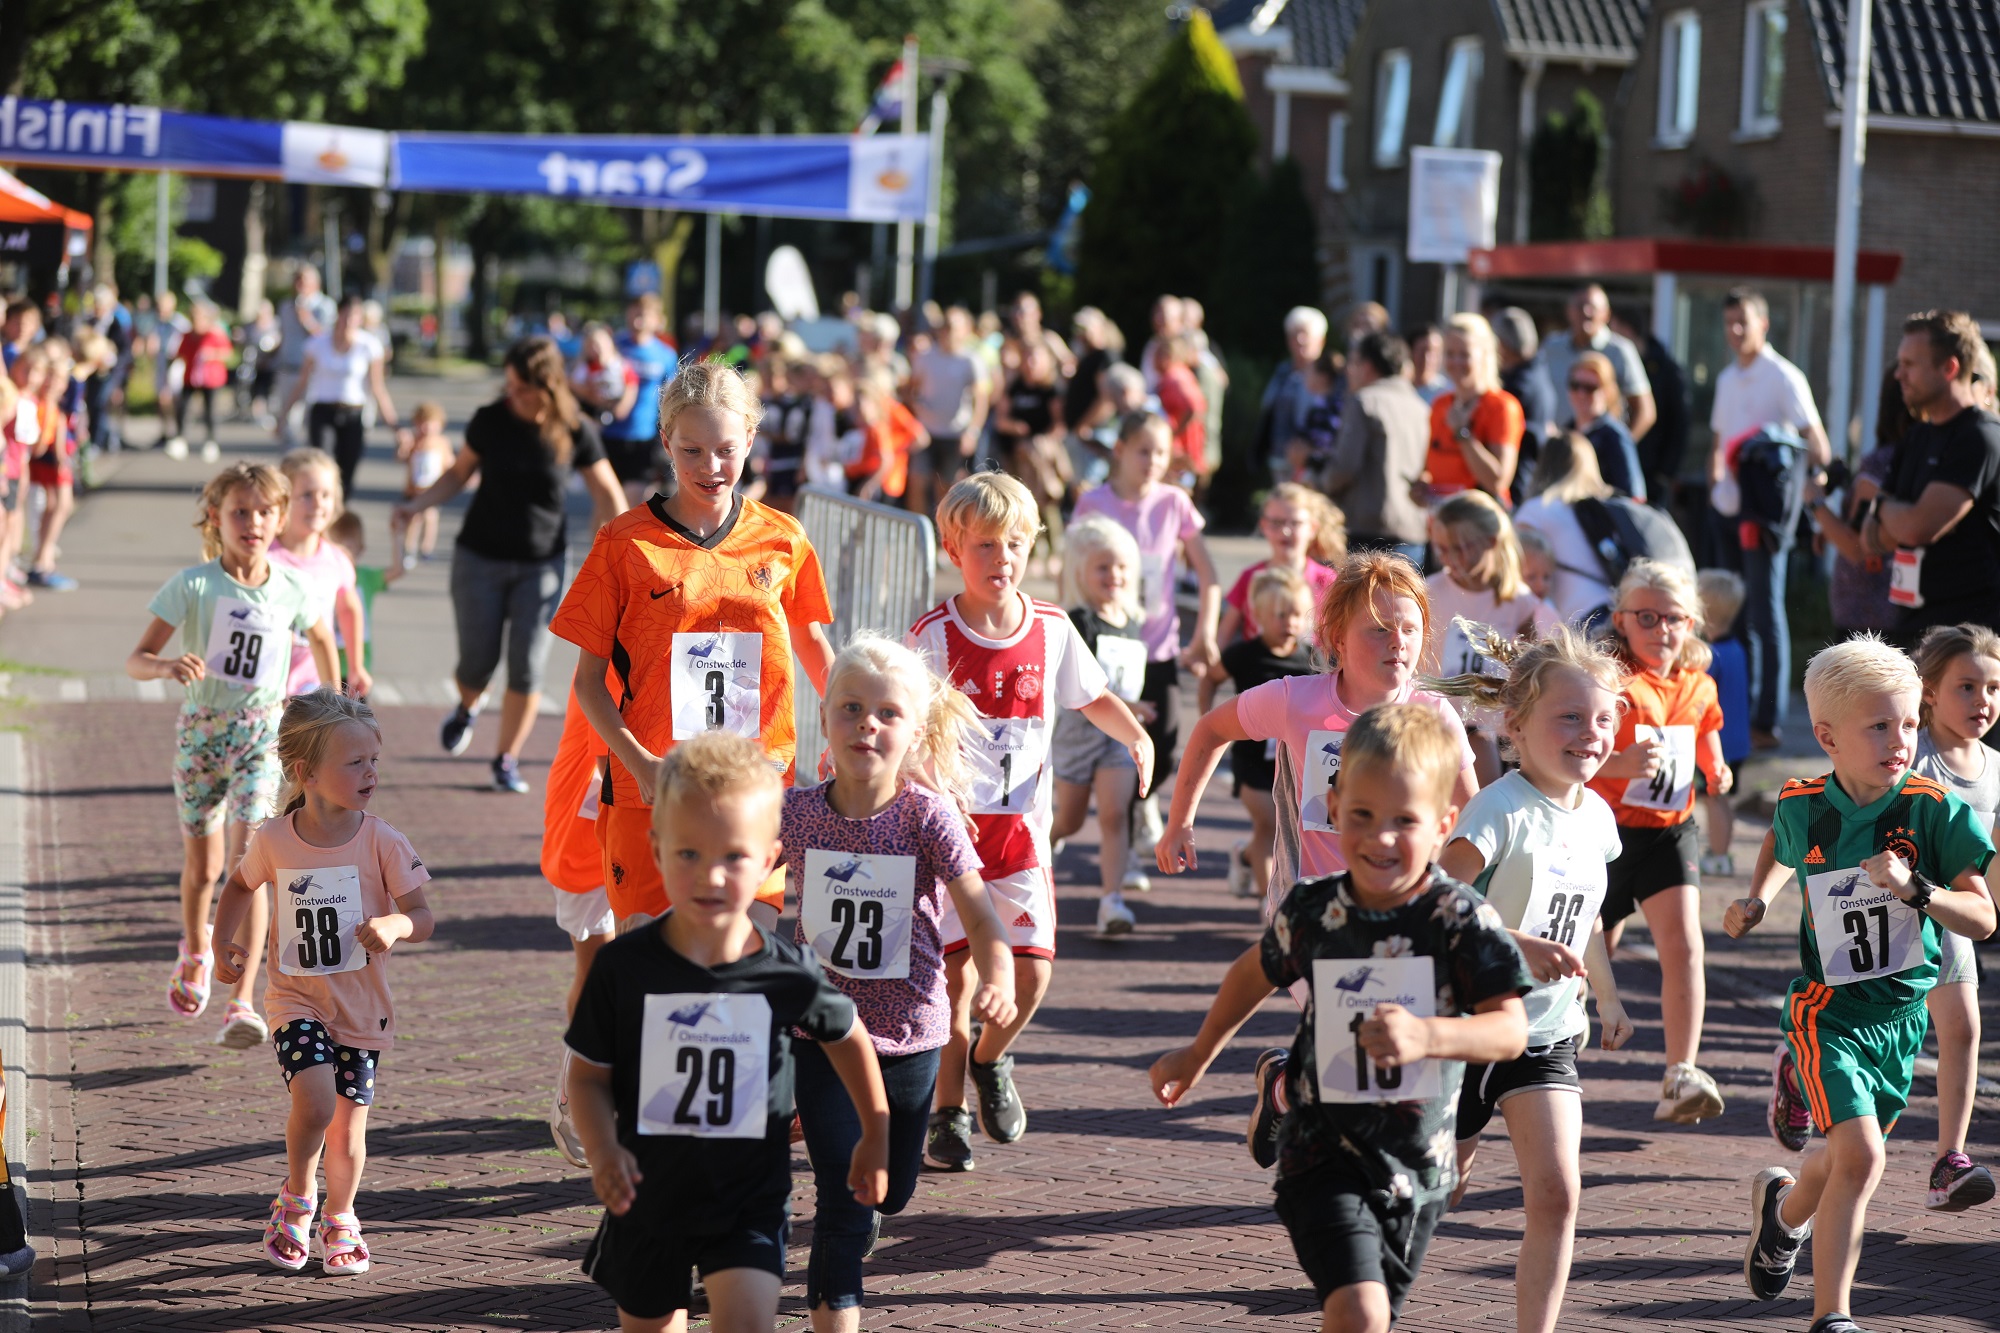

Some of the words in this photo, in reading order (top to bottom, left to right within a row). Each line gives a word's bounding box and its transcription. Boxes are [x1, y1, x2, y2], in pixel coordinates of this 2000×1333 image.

[224, 631, 262, 679] 39
[696, 659, 747, 669] Onstwedde
[705, 671, 724, 730] 3
[1000, 753, 1011, 806] 1
[1649, 758, 1676, 804] 41
[295, 894, 347, 906] Onstwedde
[834, 885, 897, 898] Onstwedde
[1840, 891, 1898, 910] Onstwedde
[295, 907, 342, 969] 38
[831, 898, 884, 970] 23
[1539, 893, 1585, 947] 36
[1843, 905, 1890, 973] 37
[678, 1030, 751, 1044] Onstwedde
[674, 1047, 735, 1126] 29
